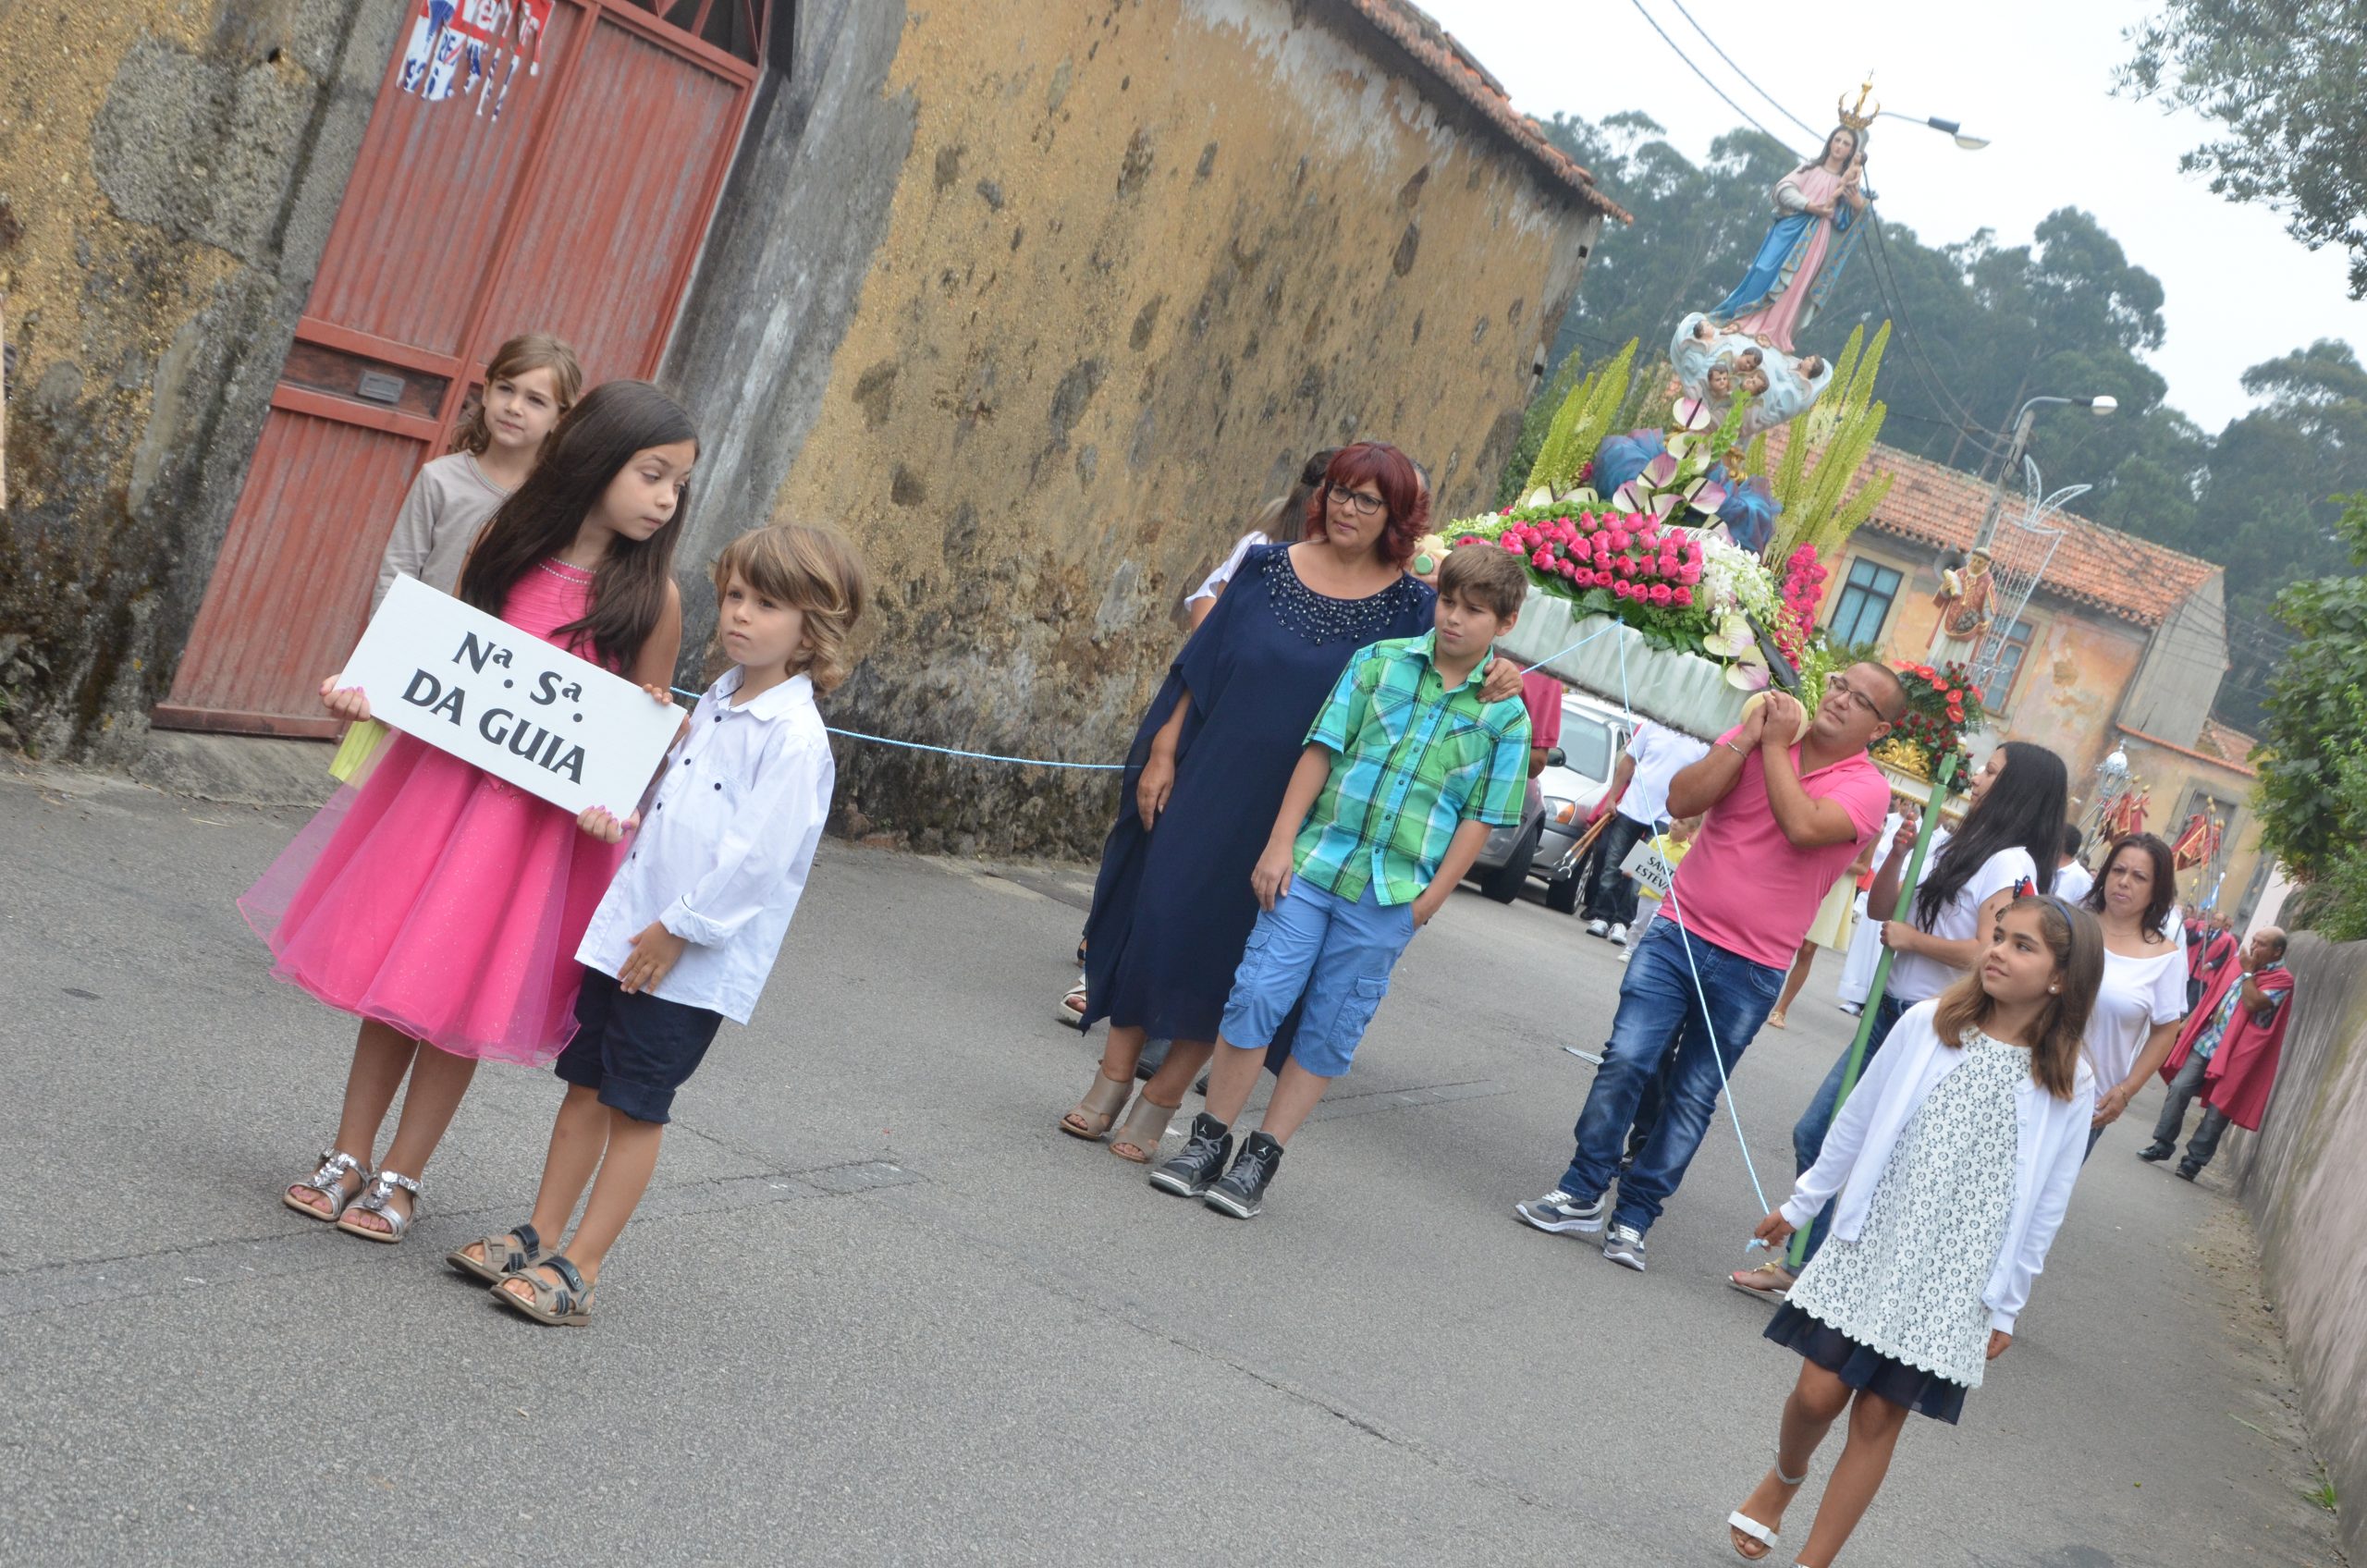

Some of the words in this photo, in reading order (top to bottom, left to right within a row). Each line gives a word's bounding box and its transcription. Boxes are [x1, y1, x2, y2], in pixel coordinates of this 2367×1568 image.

[400, 668, 466, 727] DA
[478, 707, 585, 785] GUIA
[1647, 856, 1675, 876] SANT
